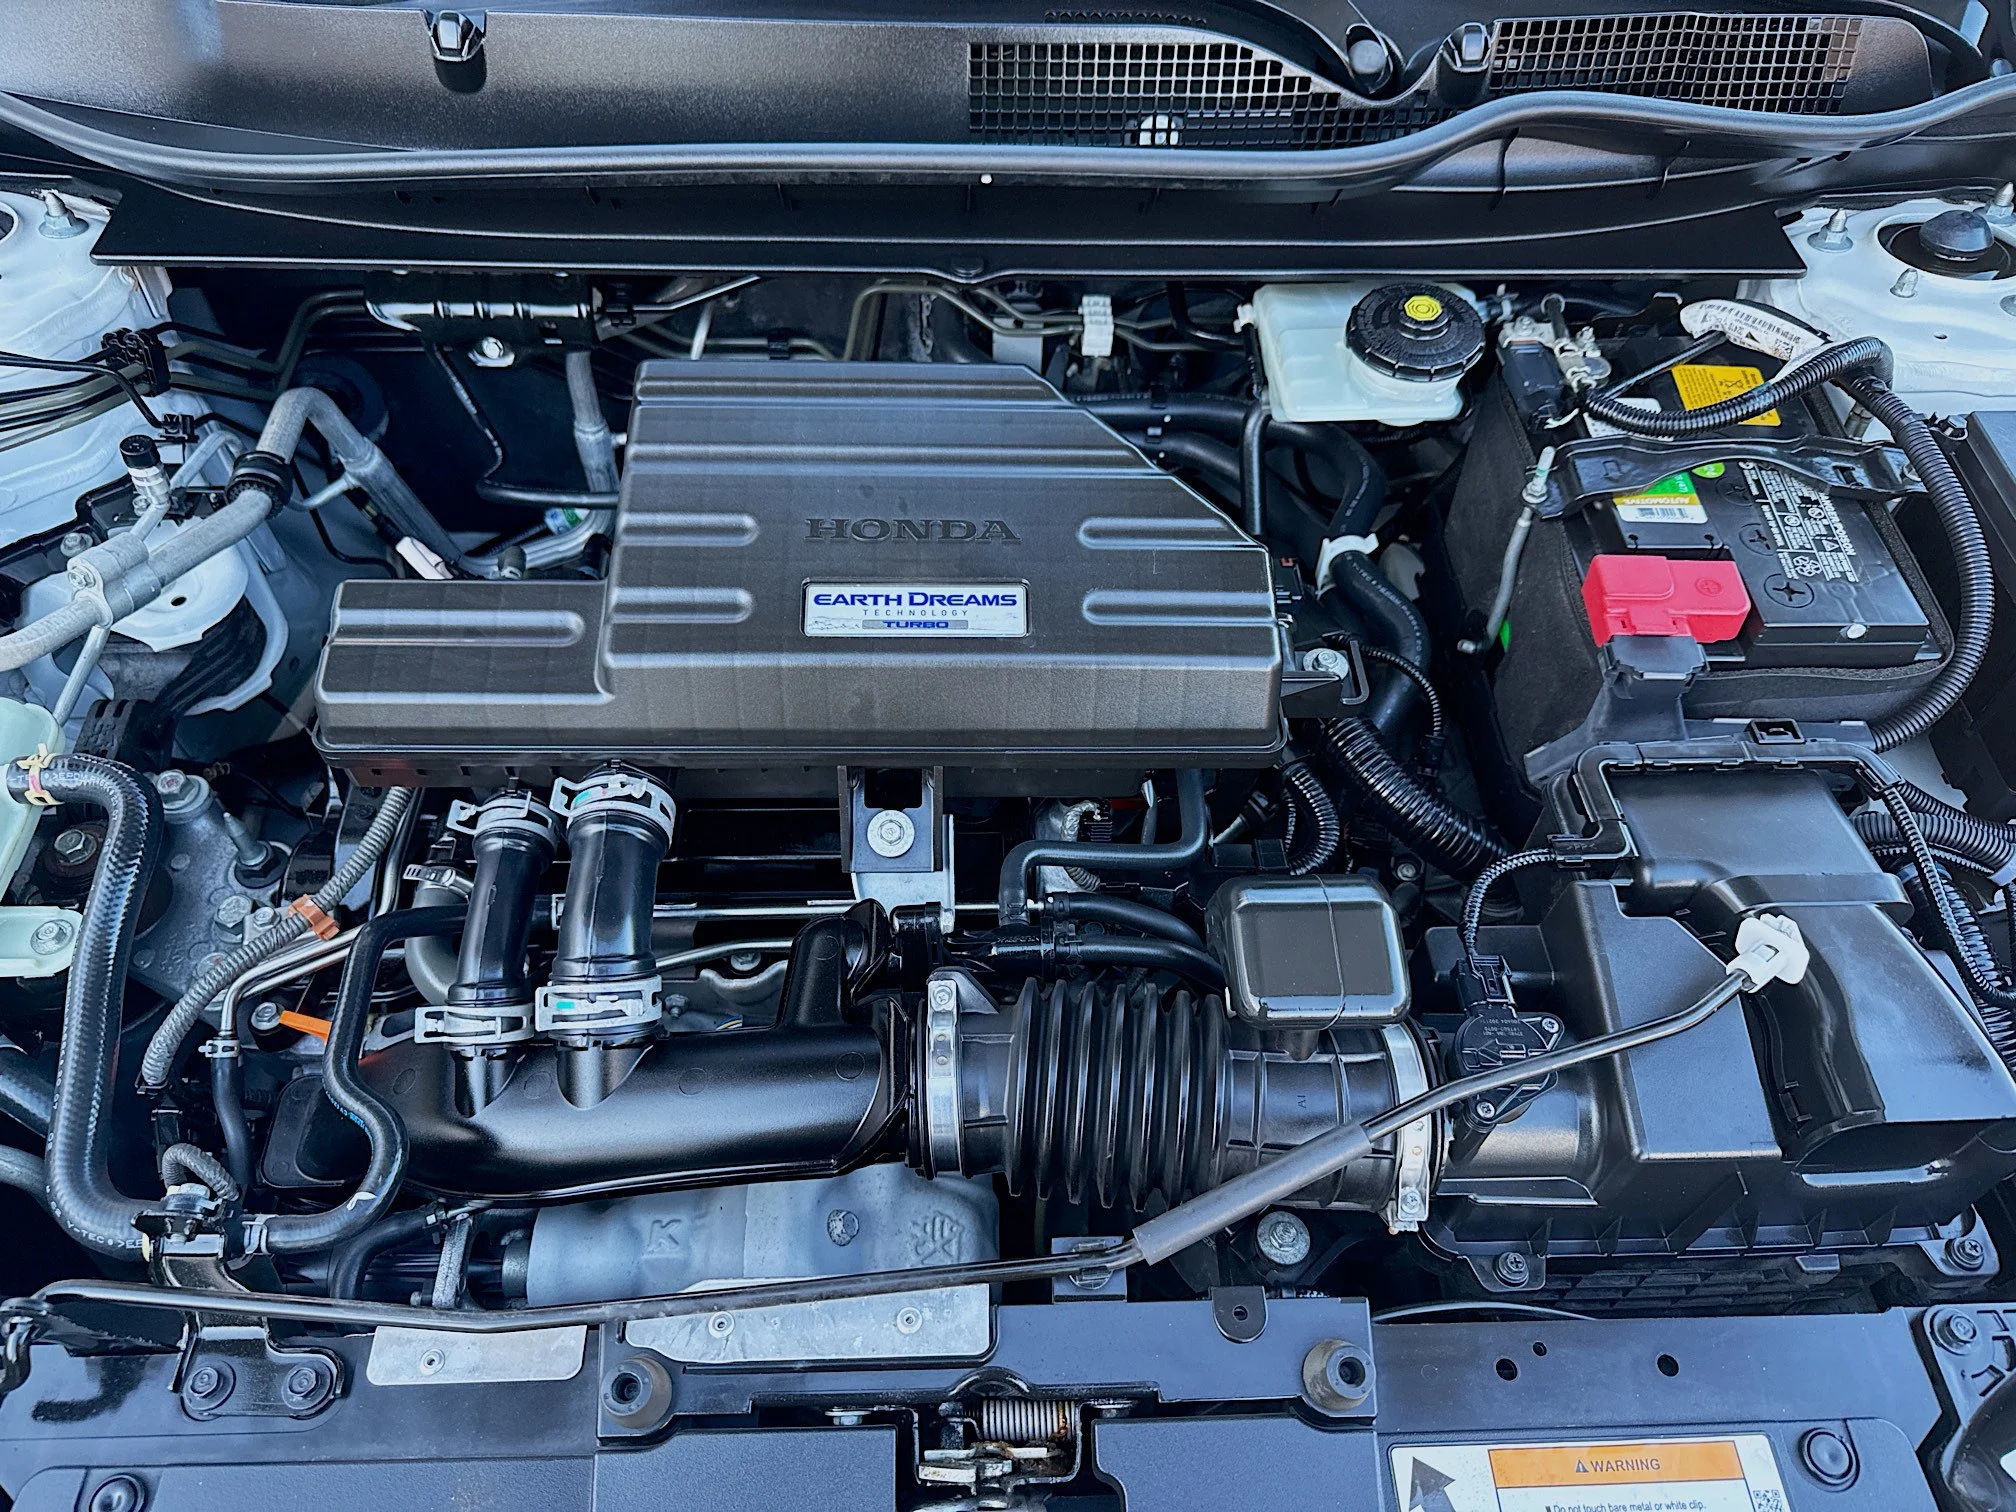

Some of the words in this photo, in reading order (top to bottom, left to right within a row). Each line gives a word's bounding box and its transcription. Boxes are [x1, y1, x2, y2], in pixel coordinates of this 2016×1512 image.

[803, 518, 1023, 543] HONDA
[813, 593, 902, 606] EARTH
[907, 592, 1017, 607] DREAMS
[863, 609, 969, 617] TECHNOLOGY
[882, 621, 949, 629] TURBO
[650, 1217, 681, 1250] K
[1590, 1458, 1660, 1472] WARNING
[1553, 1504, 1565, 1512] Do
[1568, 1504, 1581, 1512] not
[1583, 1503, 1606, 1512] touch
[1608, 1502, 1627, 1512] bare
[1629, 1502, 1652, 1511] metal
[1654, 1503, 1663, 1511] or
[1665, 1500, 1687, 1510] white
[1689, 1499, 1706, 1511] clip.
